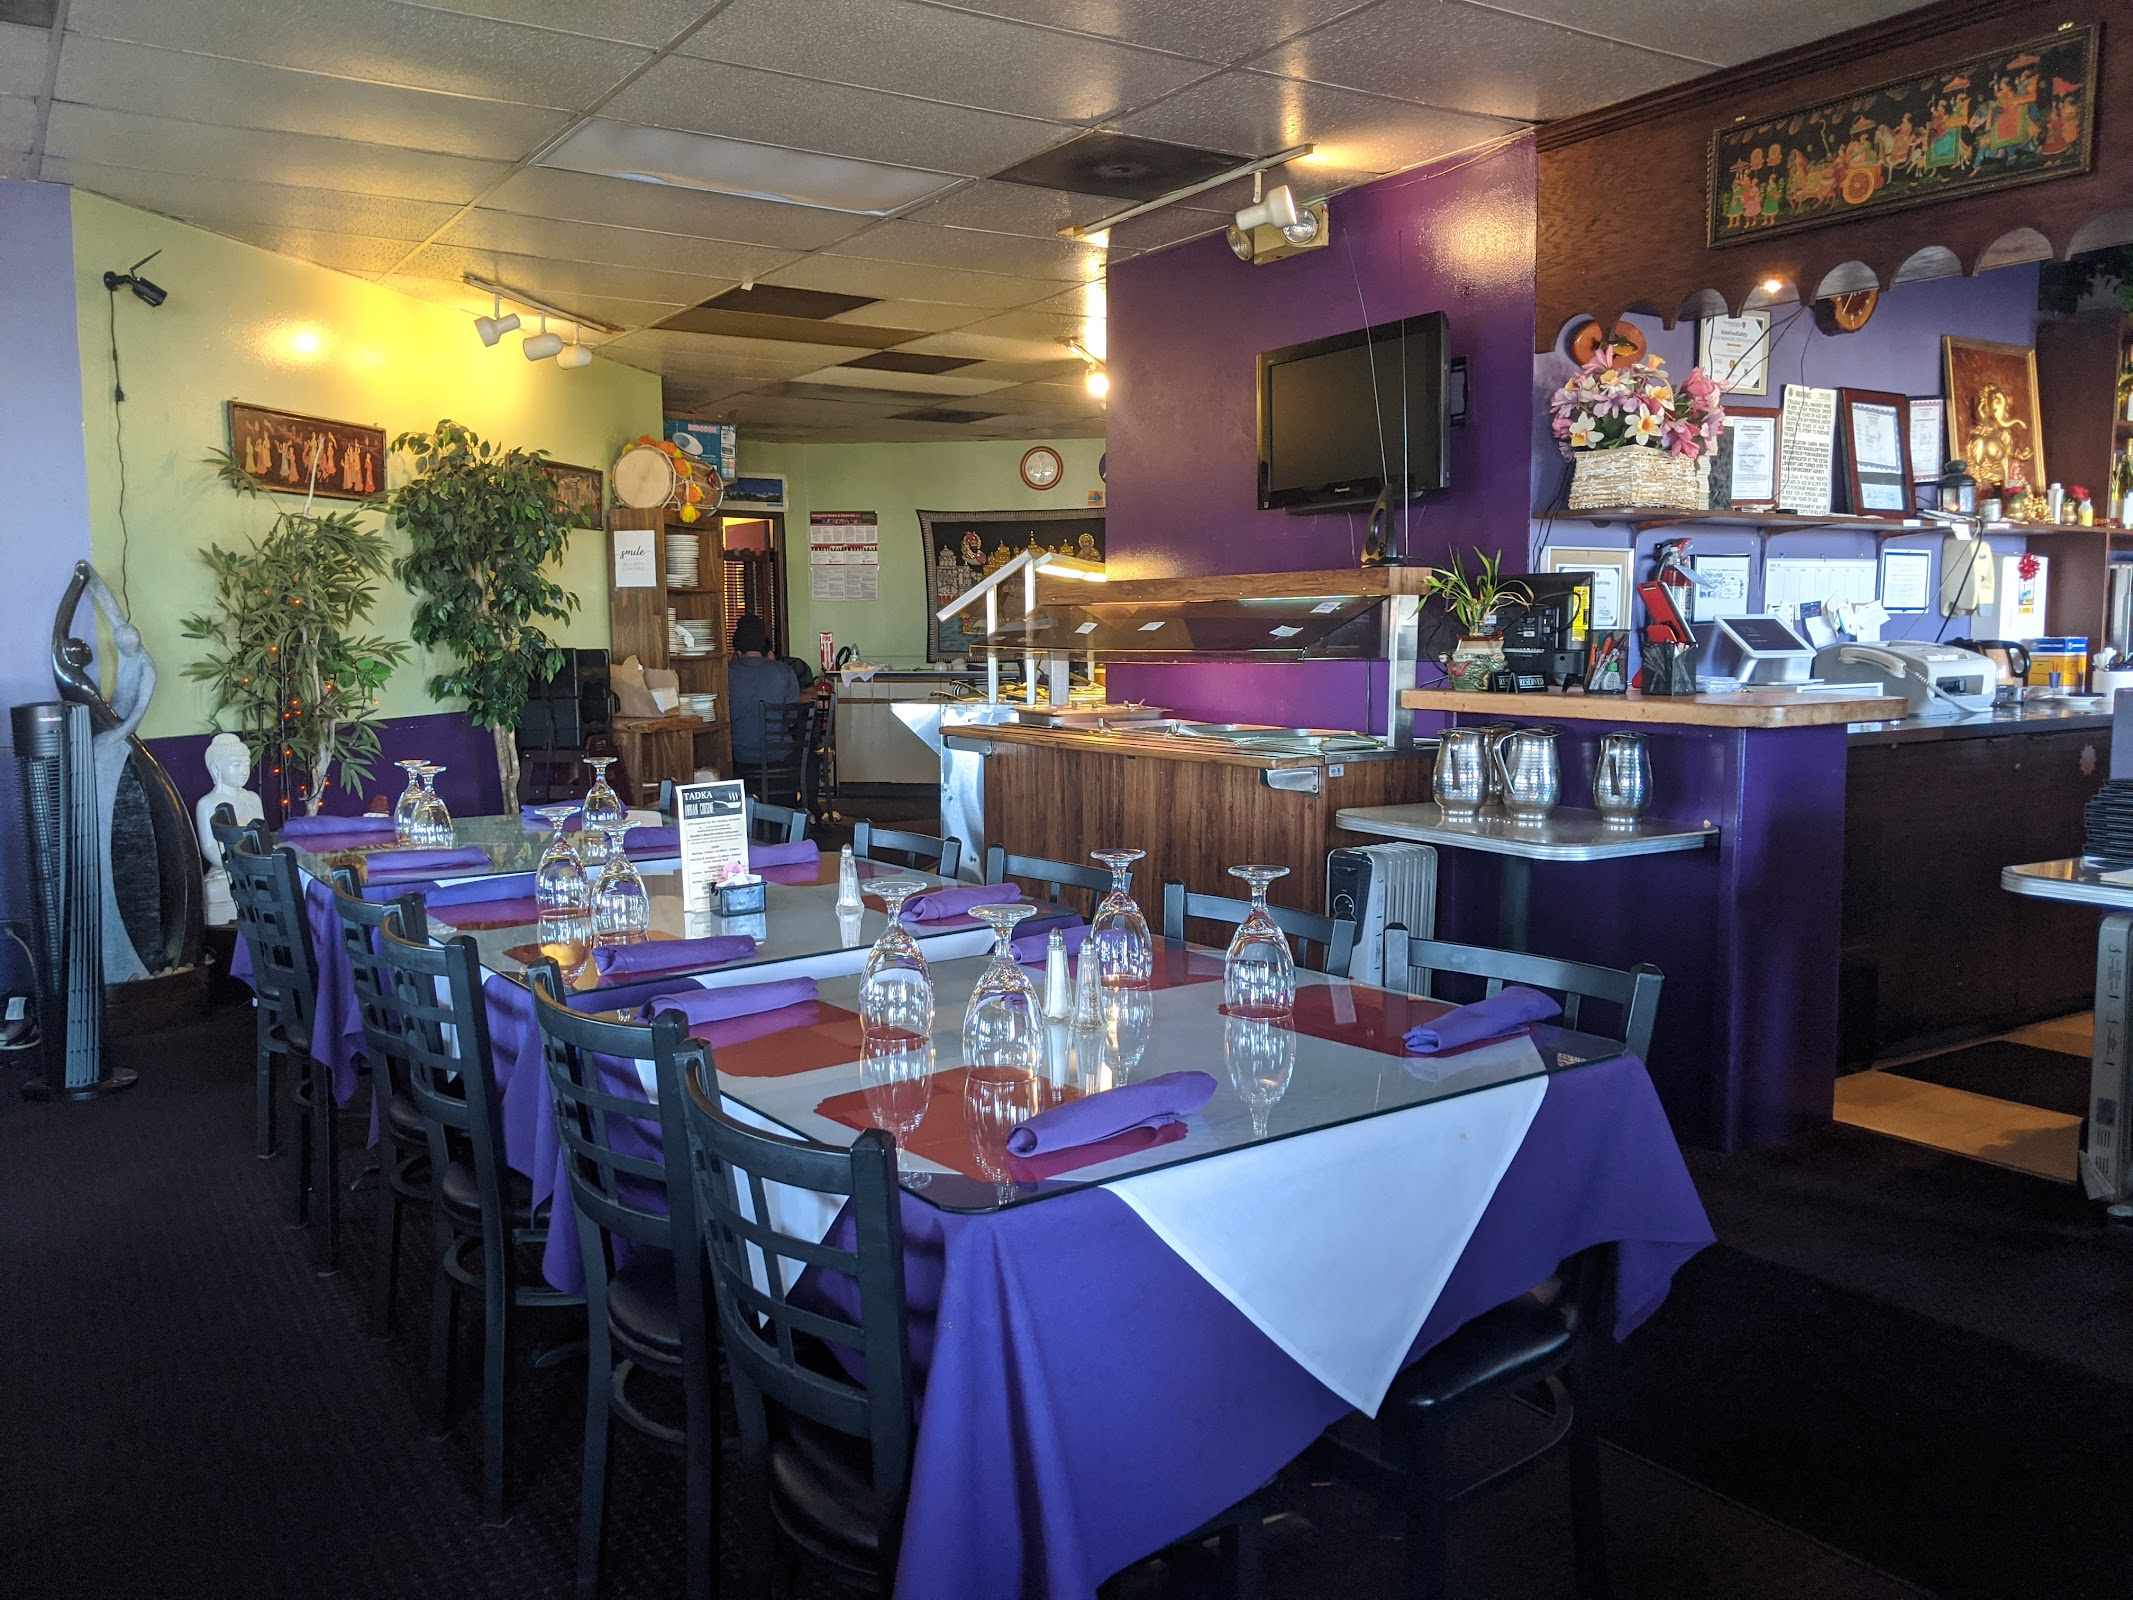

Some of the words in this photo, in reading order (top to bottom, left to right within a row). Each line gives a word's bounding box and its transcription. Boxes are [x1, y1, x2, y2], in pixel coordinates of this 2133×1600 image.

[618, 545, 648, 559] smile
[1518, 678, 1544, 686] RESERVED
[683, 790, 713, 800] TADKA
[684, 803, 698, 816] INDIAN
[700, 802, 715, 815] CUISINE
